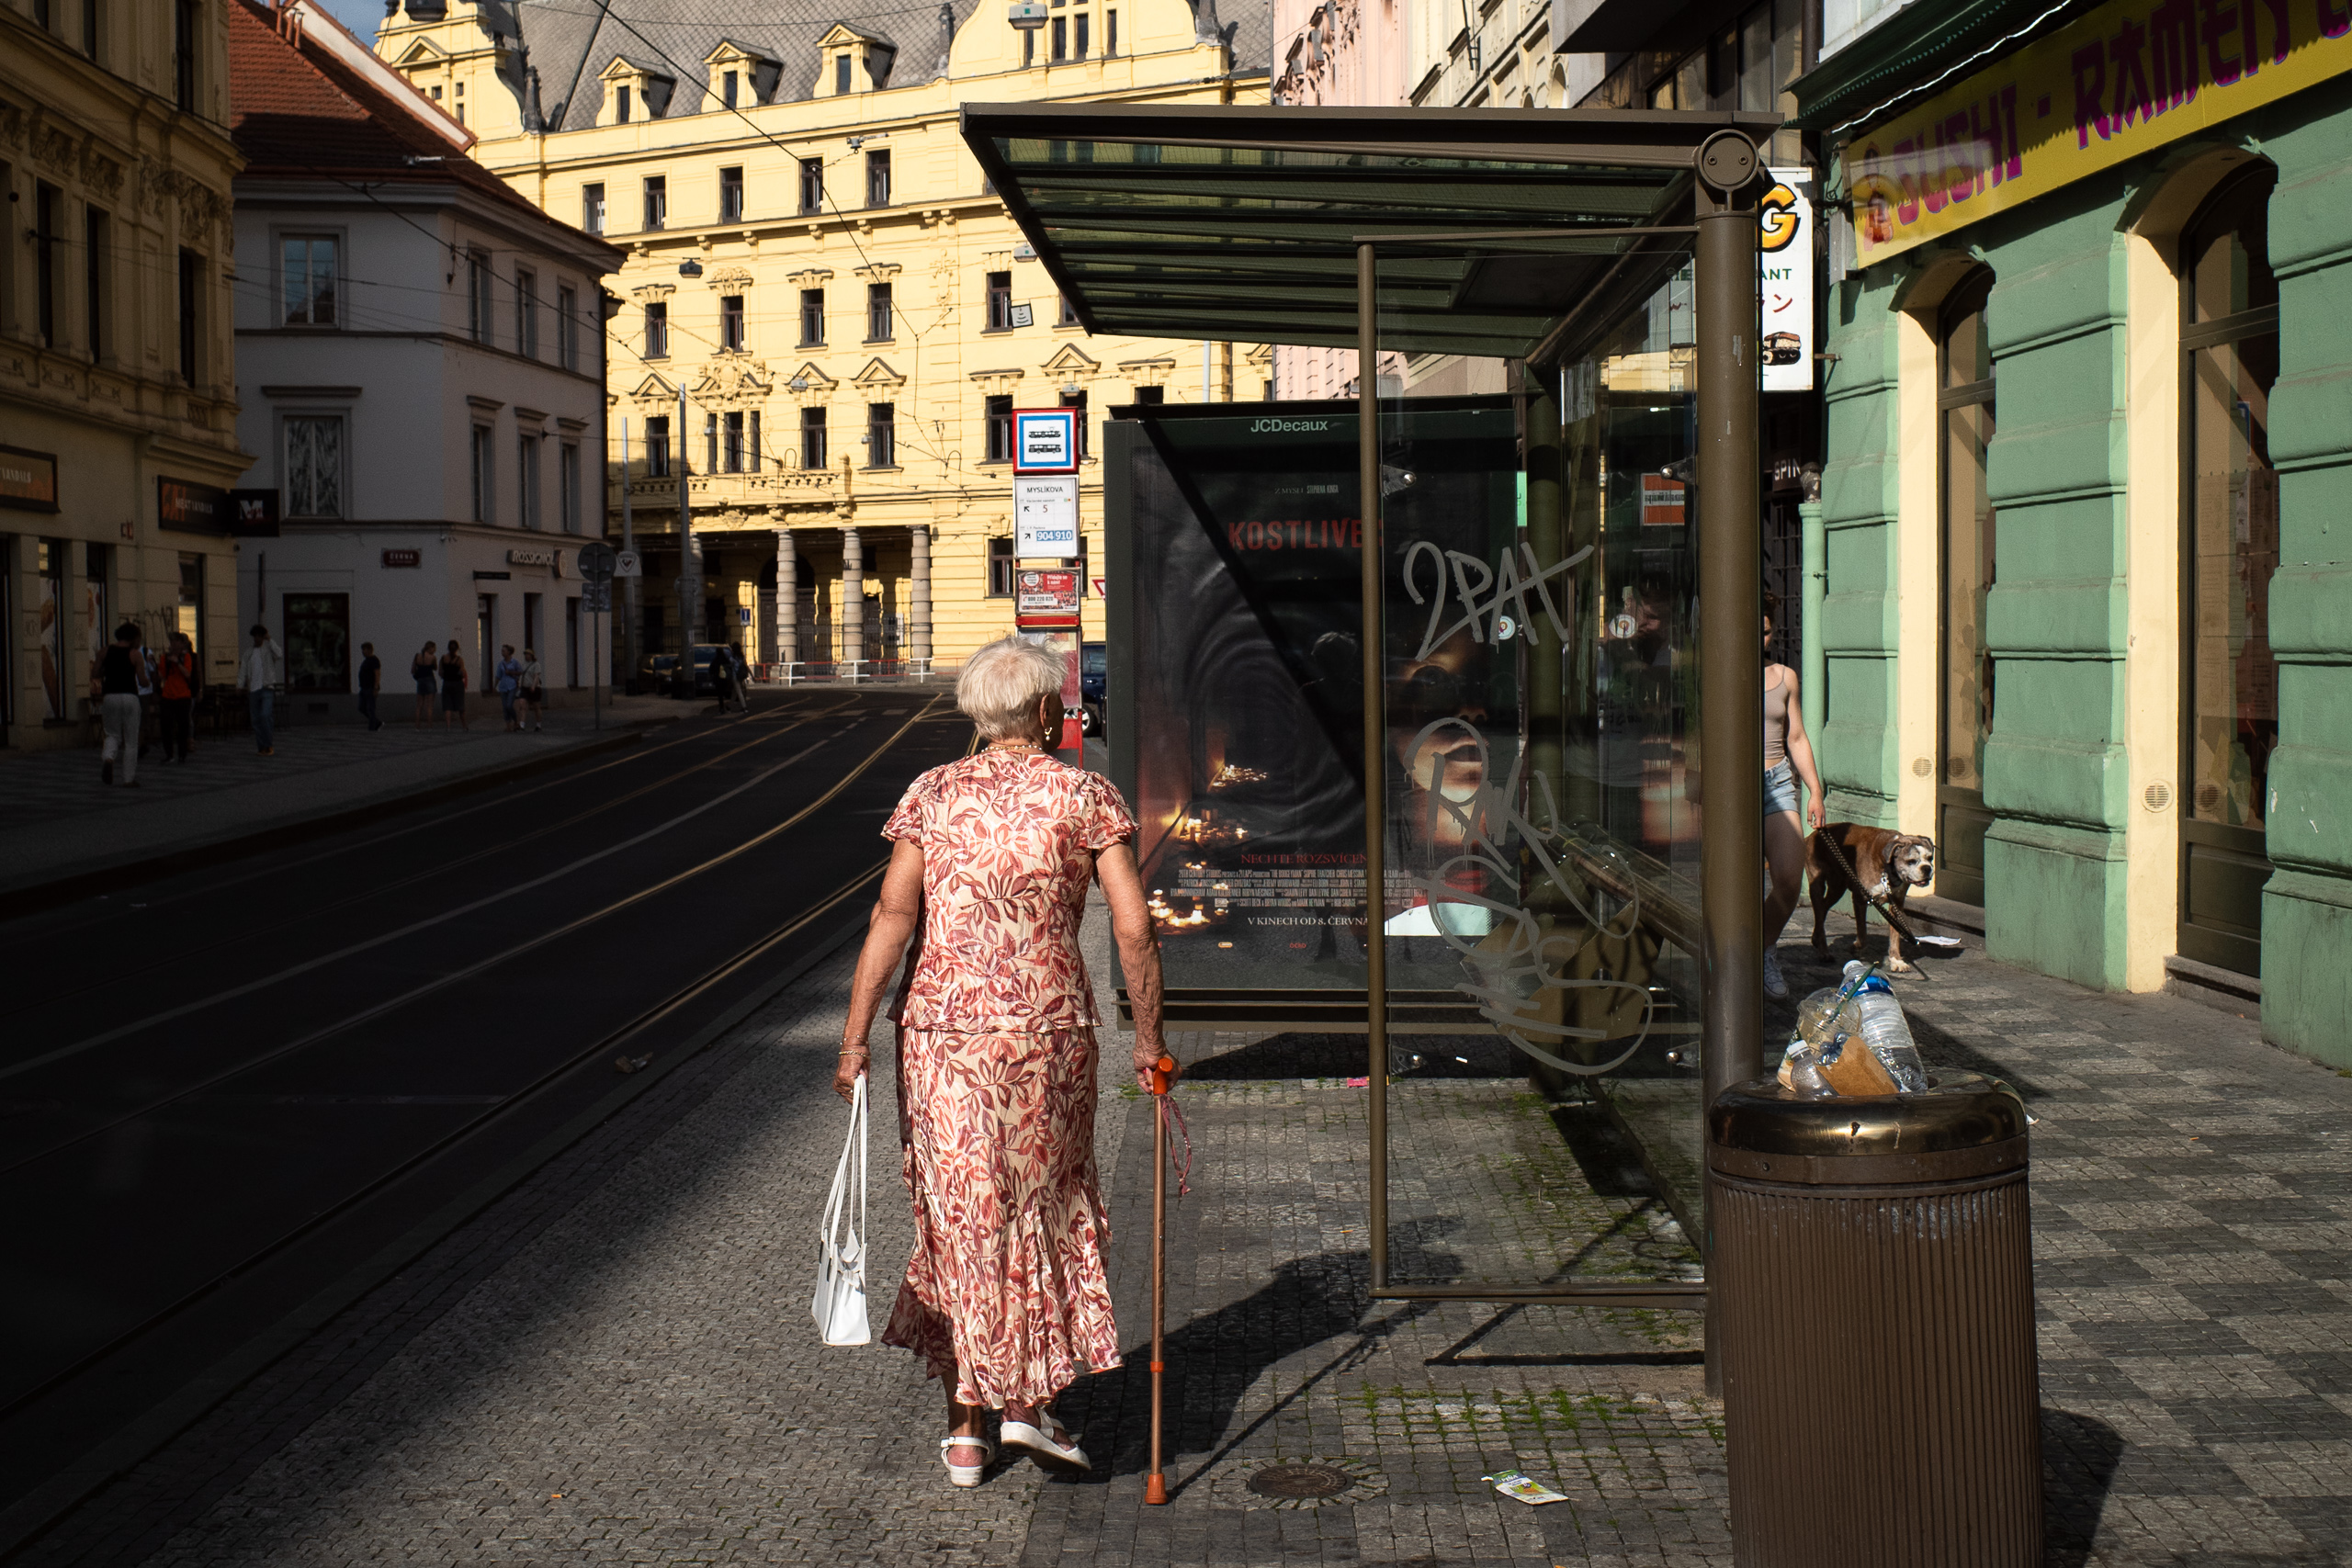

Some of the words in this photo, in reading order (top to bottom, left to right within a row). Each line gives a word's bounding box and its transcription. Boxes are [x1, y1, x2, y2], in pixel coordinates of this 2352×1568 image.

[1894, 82, 2022, 226] SUSHI
[2071, 0, 2291, 151] RAMEN
[1250, 419, 1329, 433] JCDecaux
[1043, 504, 1048, 513] 5
[1037, 531, 1054, 541] 904
[1055, 531, 1072, 540] 910
[1228, 517, 1382, 551] KOSTLIVE
[513, 549, 555, 566] ROSSIGNOL
[1241, 853, 1293, 864] NECHTE
[1296, 852, 1367, 864] ROZSVÍCEN
[1248, 917, 1255, 926] V
[1257, 917, 1297, 926] KINECH
[1299, 917, 1317, 926] OD
[1317, 917, 1326, 926] 8.
